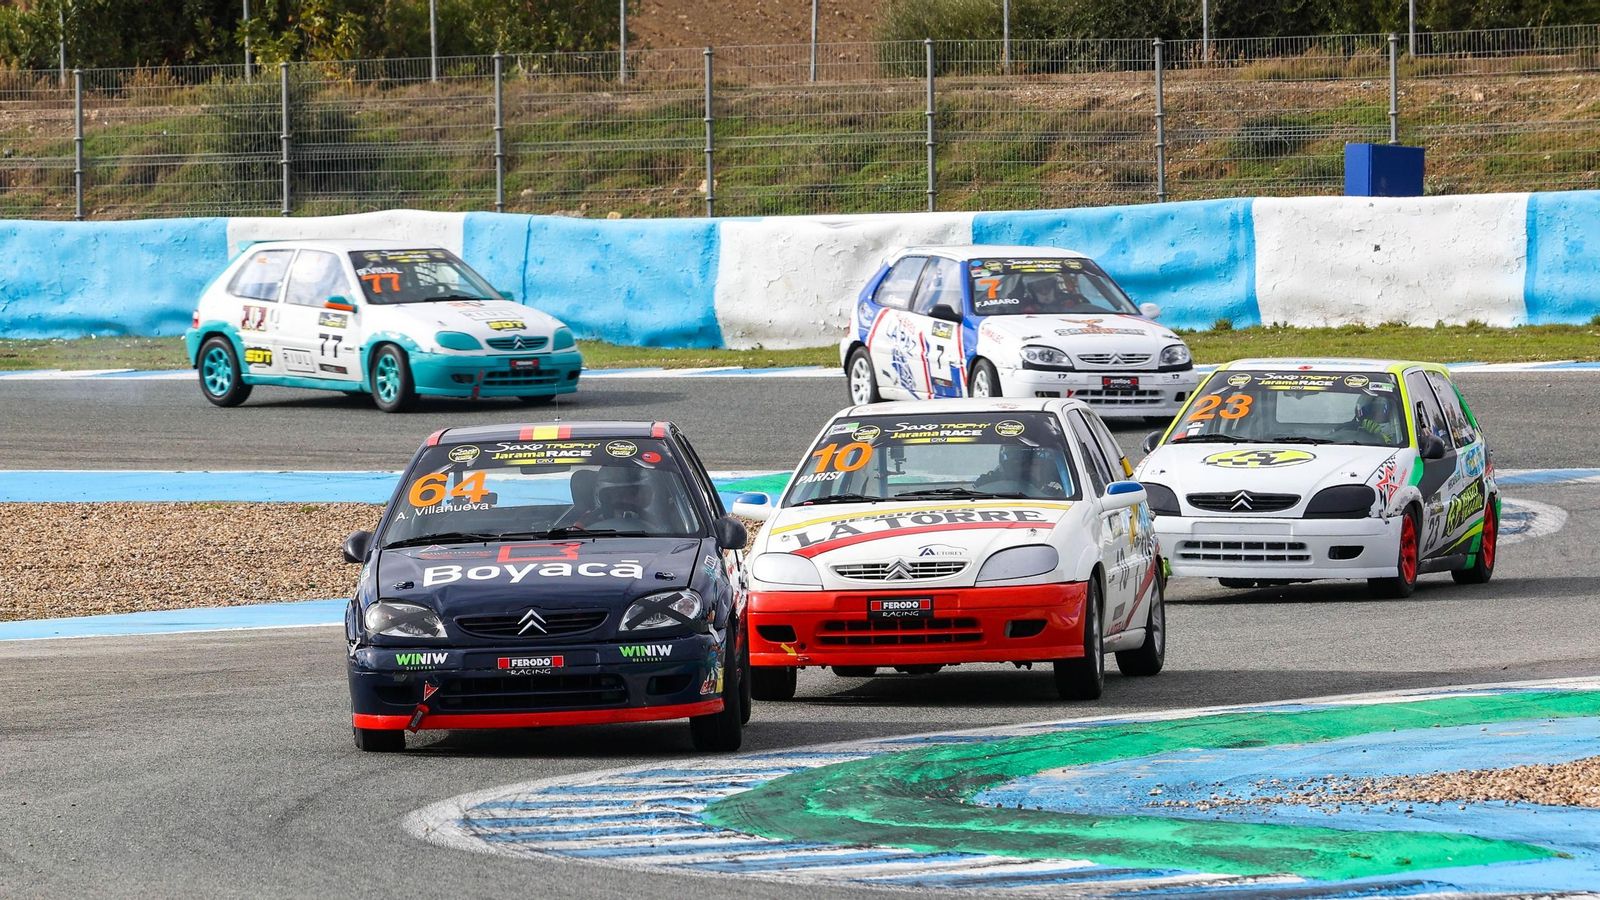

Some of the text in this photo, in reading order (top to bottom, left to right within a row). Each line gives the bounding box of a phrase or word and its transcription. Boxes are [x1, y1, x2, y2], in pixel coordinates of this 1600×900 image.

[362, 273, 401, 294] 77
[978, 280, 1001, 299] 7
[319, 333, 343, 358] 77
[936, 344, 945, 370] 7
[1187, 394, 1254, 422] 23
[884, 422, 939, 432] Saxo
[485, 443, 544, 452] Saxo
[812, 442, 873, 473] 10
[408, 470, 489, 507] 64
[395, 502, 490, 521] A. Villanueva
[795, 510, 1050, 548] LA TORRE
[883, 601, 919, 609] FERODO
[395, 652, 449, 666] WINIW
[619, 644, 673, 657] WINIW
[511, 657, 551, 667] FERODO
